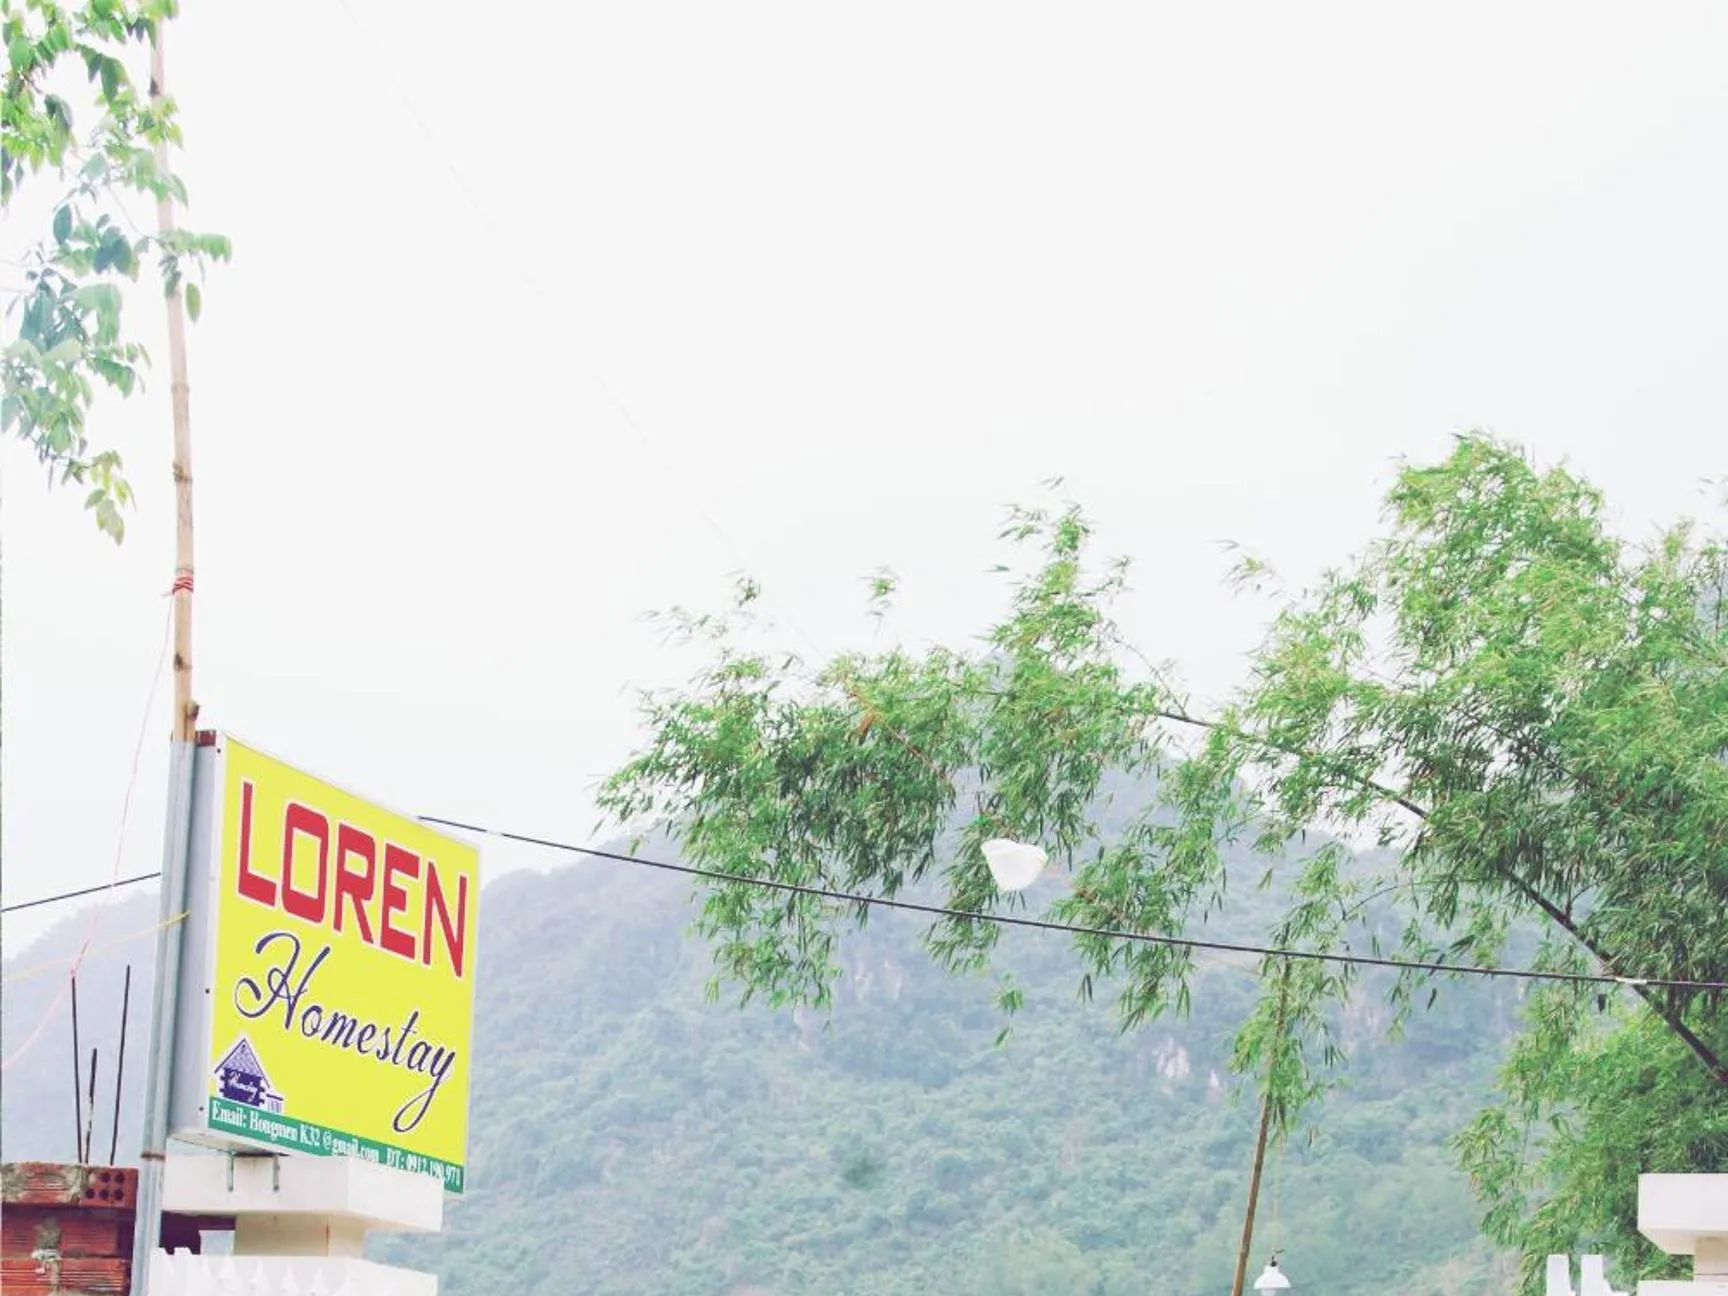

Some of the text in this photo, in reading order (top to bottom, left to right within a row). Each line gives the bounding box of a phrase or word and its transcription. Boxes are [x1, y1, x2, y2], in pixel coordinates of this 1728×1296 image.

[238, 781, 467, 978] LOREN
[212, 1099, 247, 1128] Email:
[235, 932, 456, 1132] Homestay
